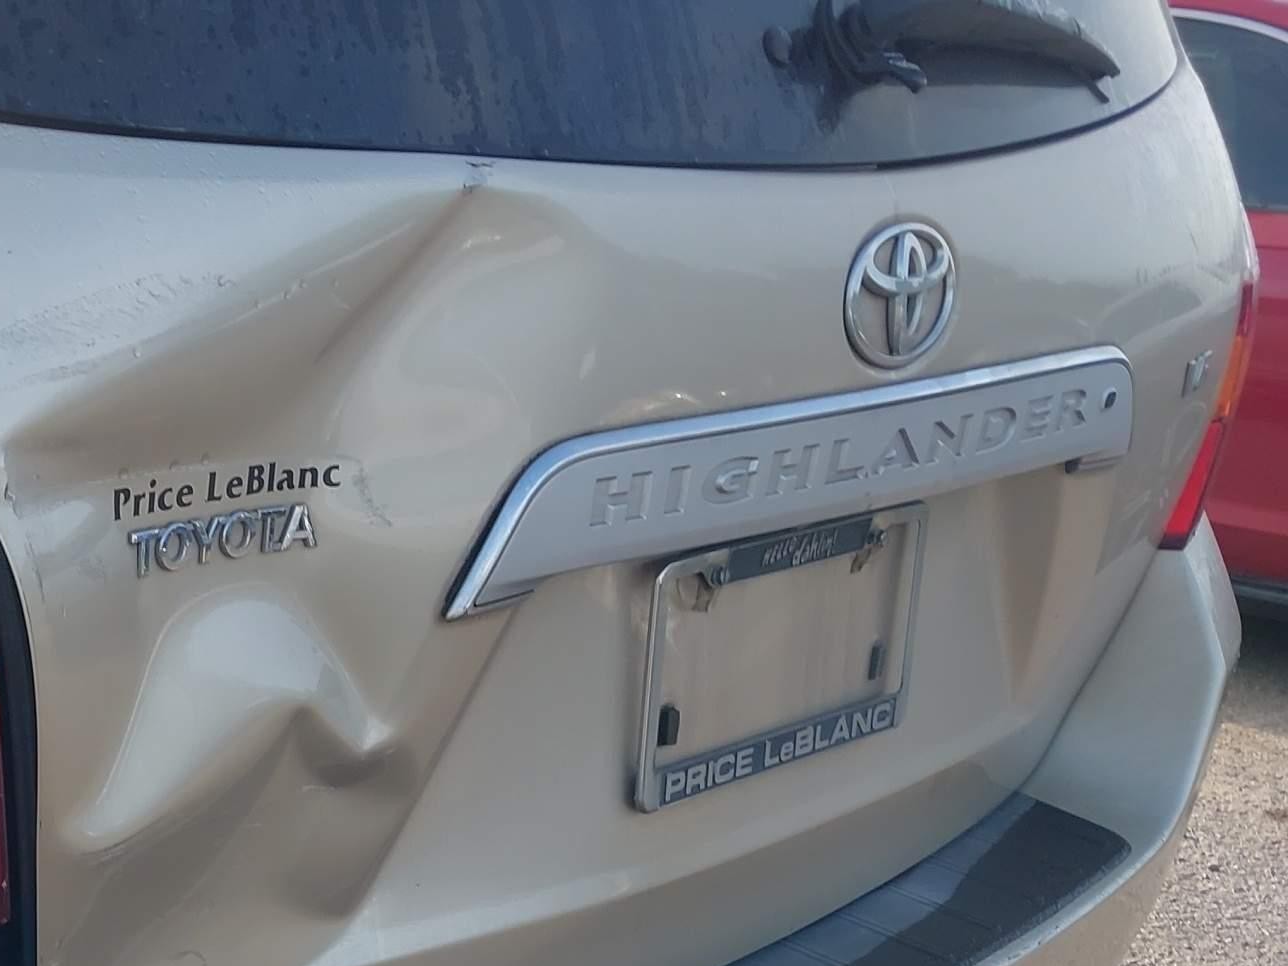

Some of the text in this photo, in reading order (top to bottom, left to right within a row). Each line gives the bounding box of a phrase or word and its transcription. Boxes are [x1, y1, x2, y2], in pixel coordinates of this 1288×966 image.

[113, 462, 342, 521] Price LeBlanc
[589, 387, 1089, 527] HIGHLANDER
[127, 503, 318, 579] TOYOTA
[663, 701, 894, 802] PRICE LeBLANC
